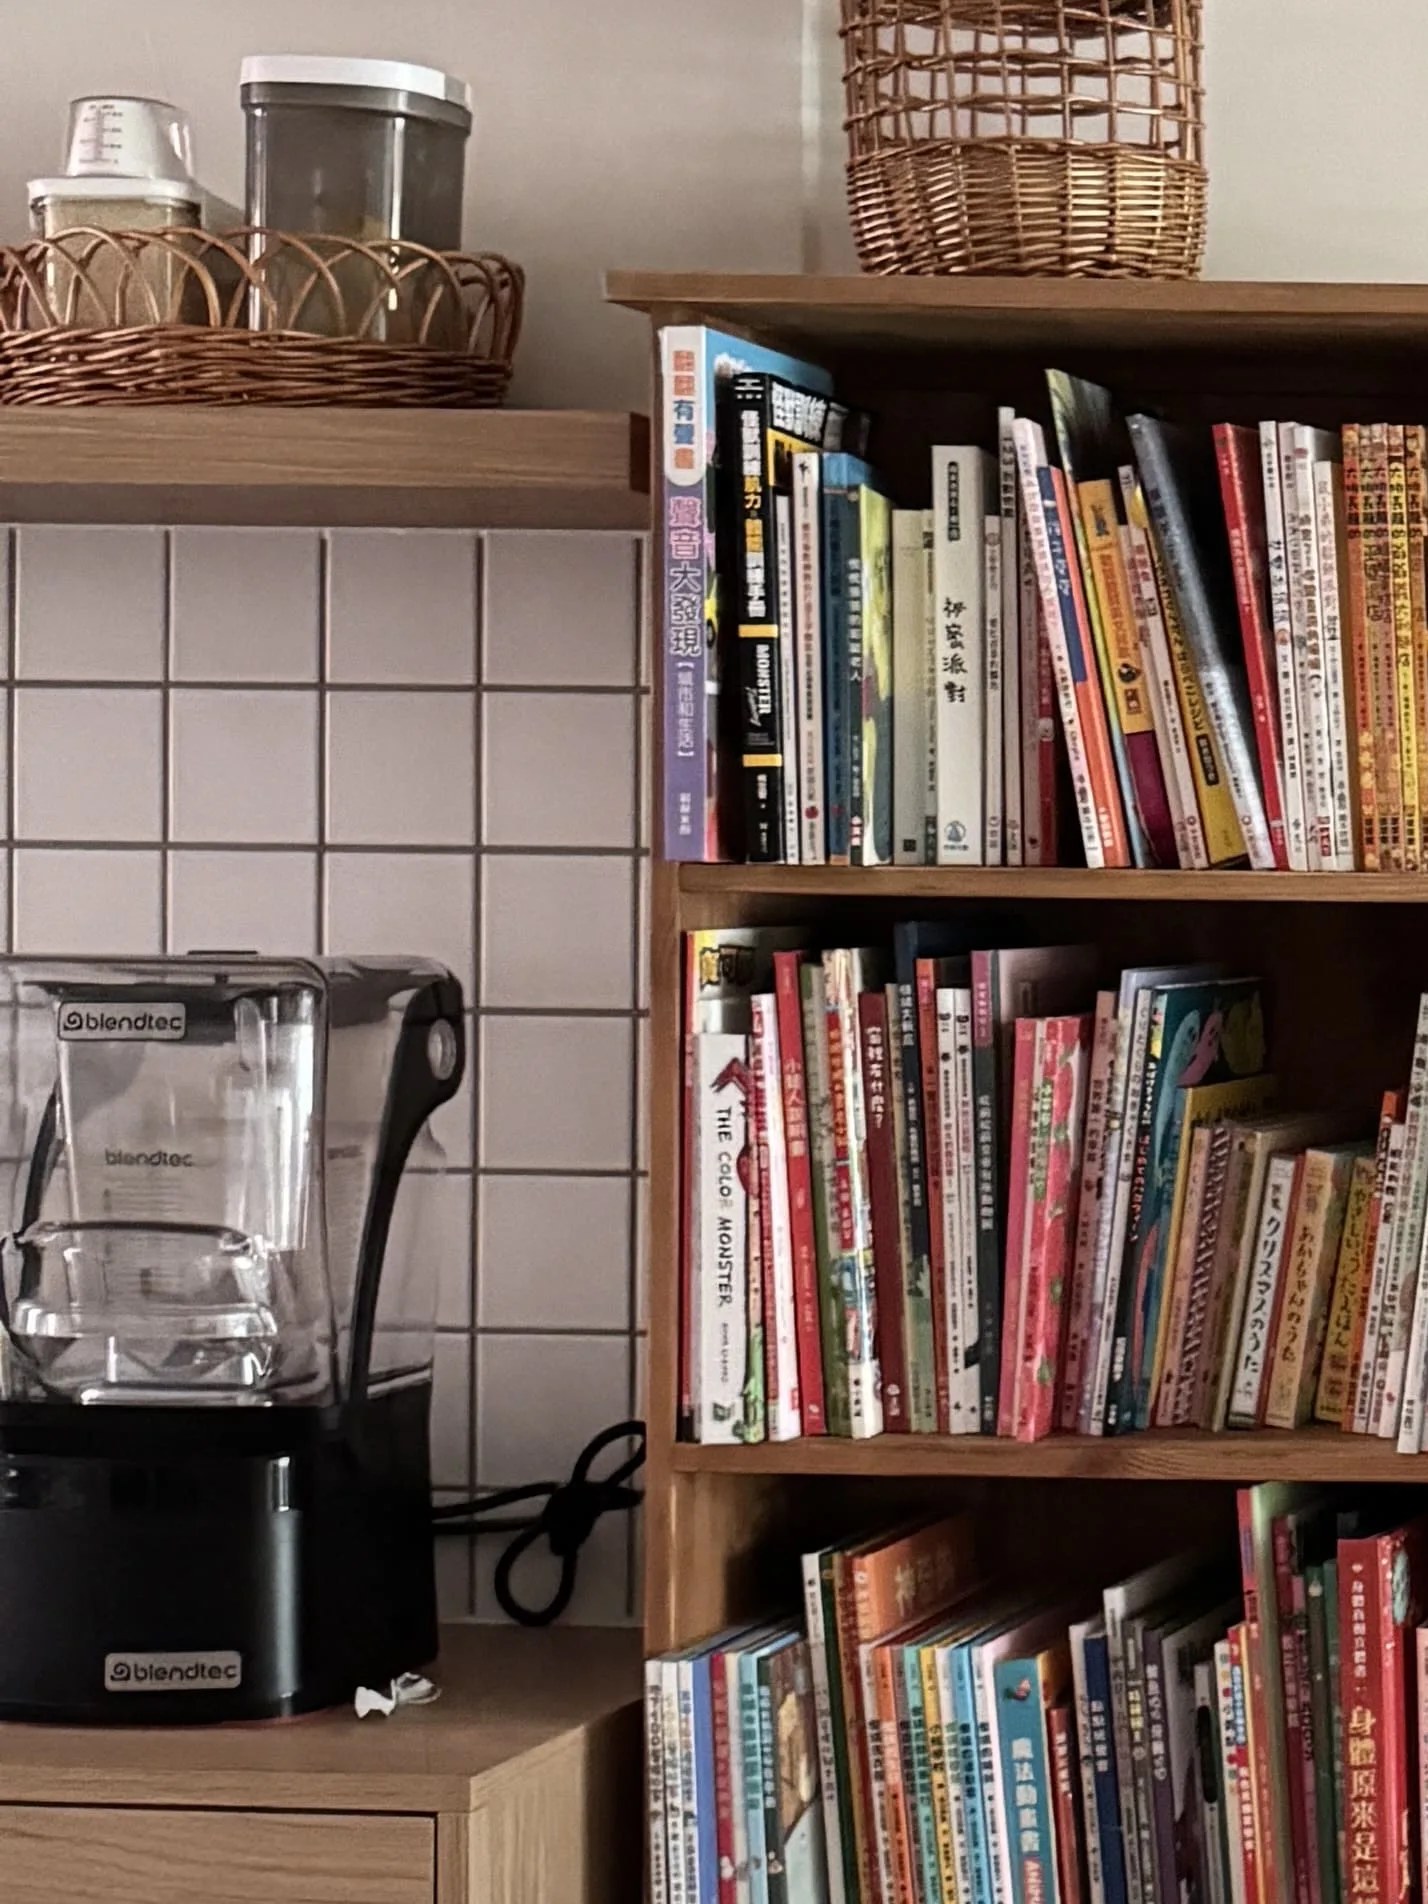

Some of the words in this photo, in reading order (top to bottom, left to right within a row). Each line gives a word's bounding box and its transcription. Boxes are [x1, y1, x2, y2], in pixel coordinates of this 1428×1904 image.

[669, 496, 701, 656] 聲音大發現
[756, 644, 772, 714] MONSTER
[85, 1012, 183, 1031] blendtec
[716, 1106, 732, 1142] THE
[105, 1148, 193, 1167] blendtec
[717, 1152, 732, 1208] COLOR
[716, 1215, 733, 1308] MONSTER
[133, 1663, 237, 1681] blendtec
